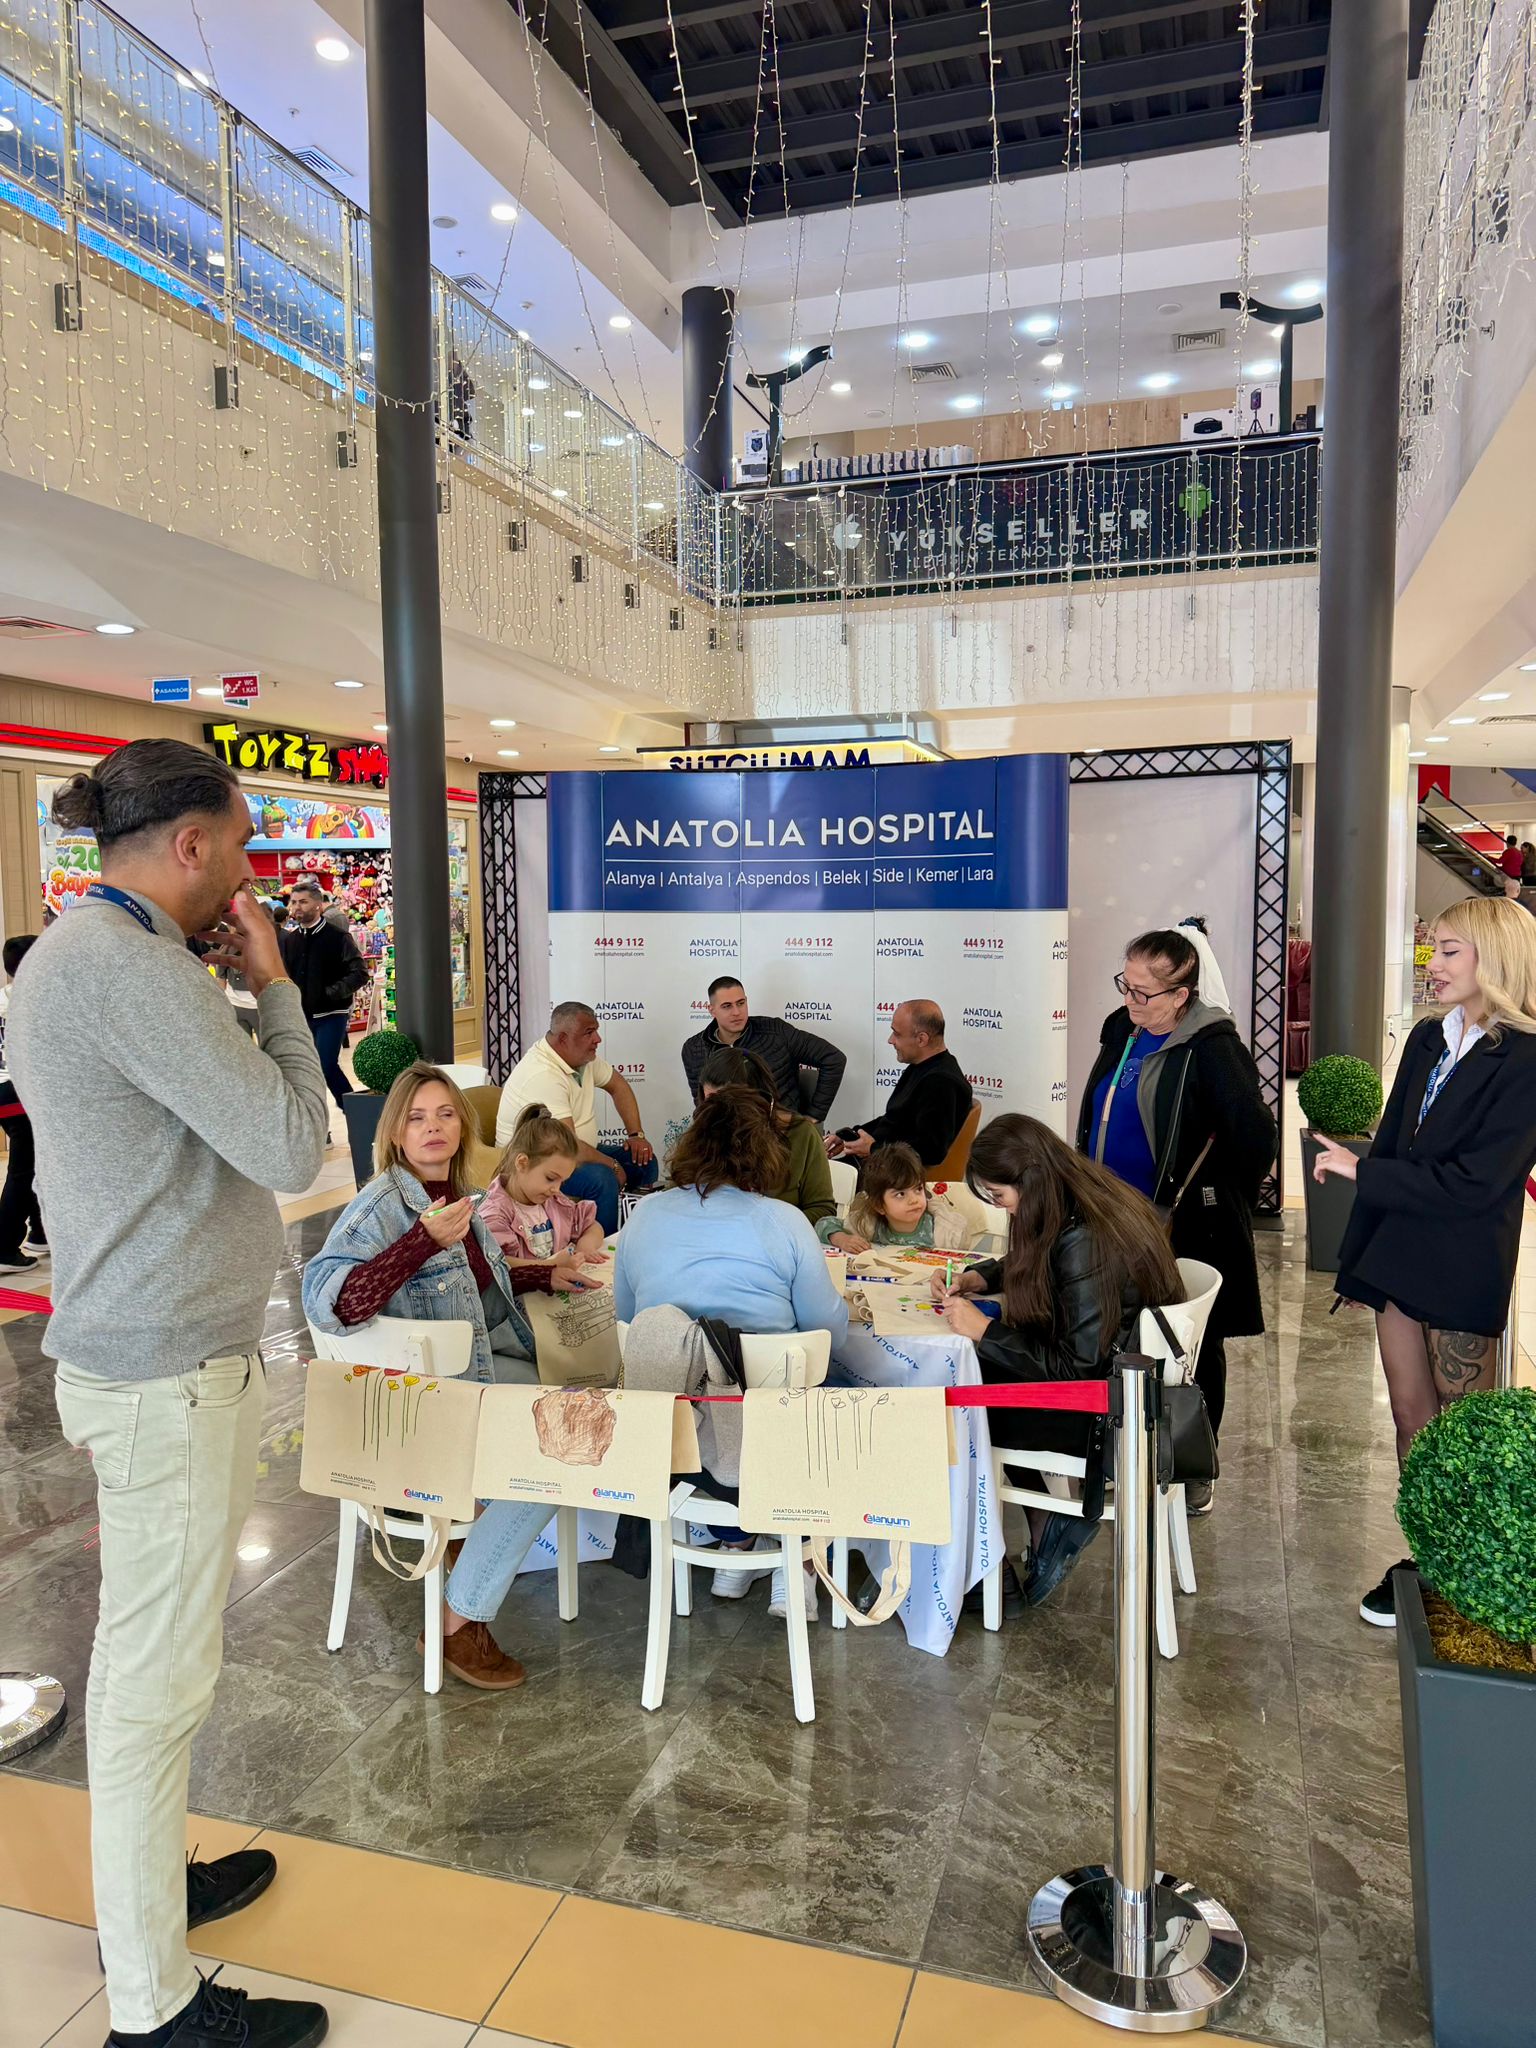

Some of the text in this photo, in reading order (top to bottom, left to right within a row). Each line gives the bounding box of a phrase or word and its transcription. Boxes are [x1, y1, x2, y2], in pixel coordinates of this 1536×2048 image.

[160, 686, 189, 694] ASANSÖR
[605, 808, 995, 848] ANATOLIA HOSPITAL
[605, 865, 994, 889] Alanya Antalya Aspendos Belek Side Kemer Lara
[594, 937, 645, 947] 444 9 112
[689, 938, 739, 947] ANATOLIA
[785, 937, 833, 947] 444 9 112
[876, 937, 925, 947] ANATOLIA
[963, 938, 1004, 949] 444 9 112
[689, 948, 739, 957] HOSPITAL
[876, 948, 925, 957] HOSPITAL
[595, 1001, 645, 1010] ANATOLIA
[785, 1001, 833, 1011] ANATOLIA
[876, 1002, 895, 1012] 444
[594, 1011, 645, 1021] HOSPITAL
[784, 1011, 832, 1021] HOSPITAL
[963, 1007, 1003, 1019] ANATOLIA
[962, 1018, 1003, 1030] HOSPITAL
[618, 1063, 645, 1073] 9 112
[979, 1076, 985, 1086] 9
[987, 1077, 1003, 1089] 112
[977, 1473, 989, 1535] HOSPITAL
[802, 1508, 830, 1516] HOSPITAL
